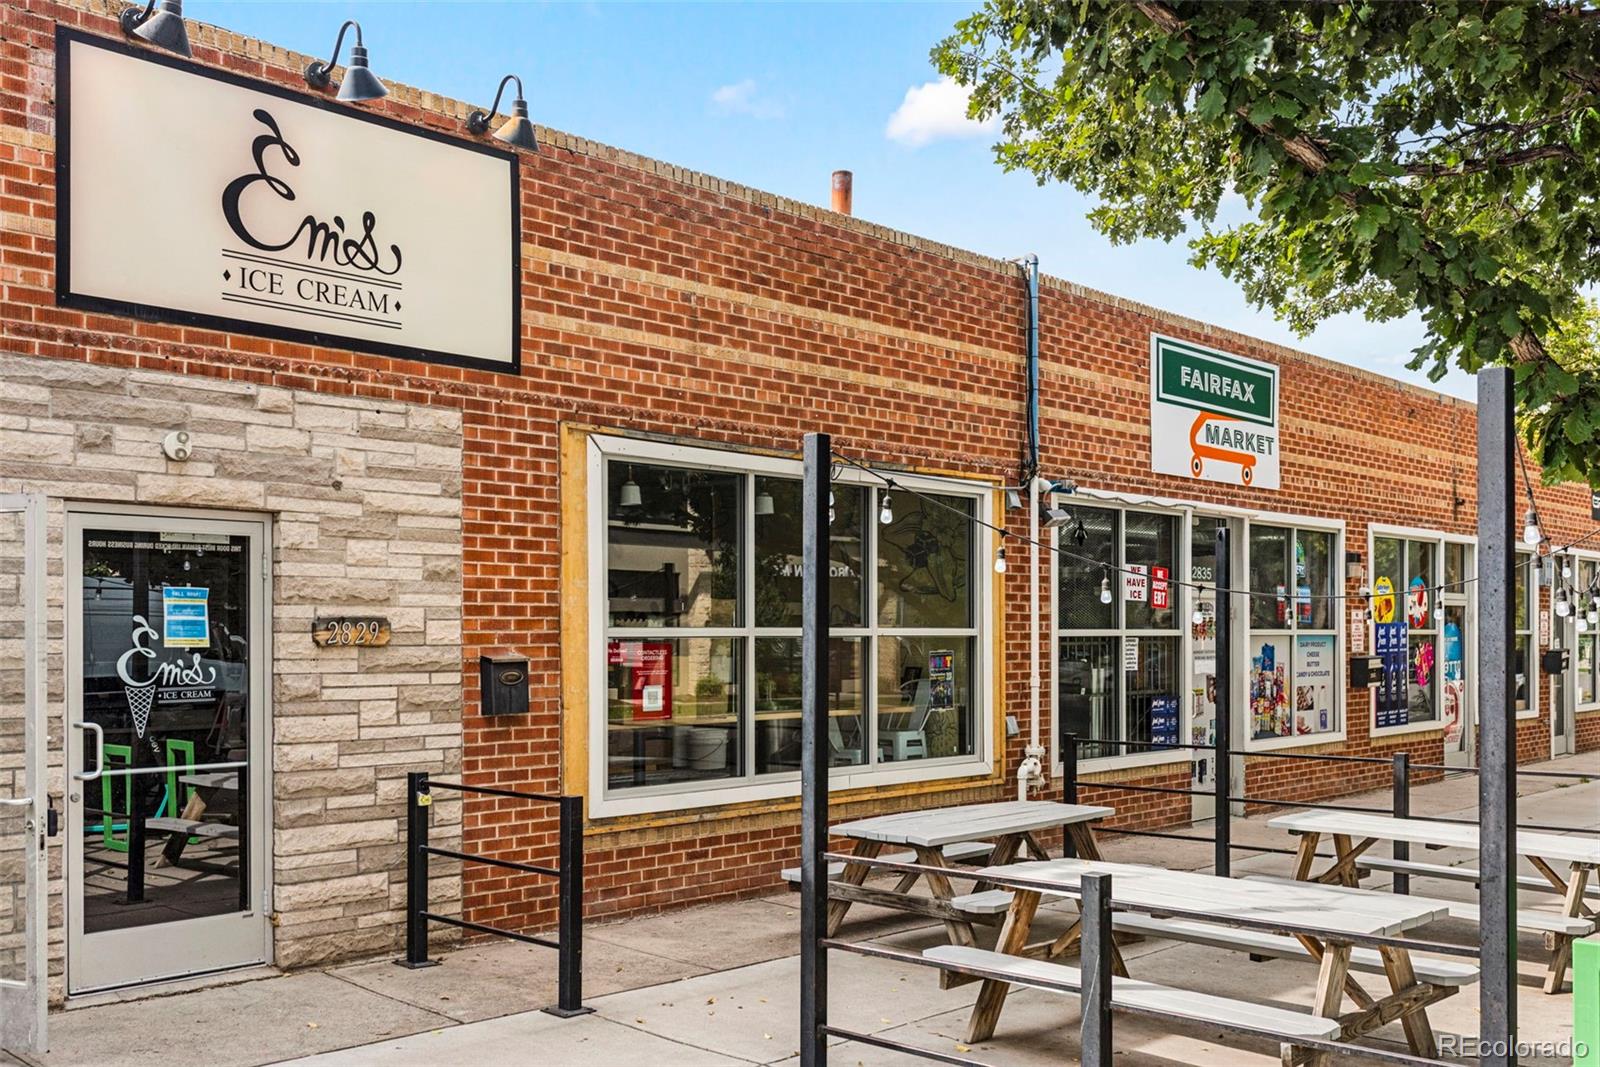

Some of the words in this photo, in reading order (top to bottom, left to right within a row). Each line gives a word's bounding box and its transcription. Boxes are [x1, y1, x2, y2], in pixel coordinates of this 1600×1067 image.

[222, 109, 402, 275] Em's
[239, 267, 285, 295] ICE
[296, 279, 389, 314] CREAM
[1180, 366, 1255, 404] FAIRFAX
[1205, 424, 1275, 455] MARKET
[1192, 566, 1212, 580] 2835
[1126, 578, 1146, 587] HAVE
[1130, 591, 1142, 599] ICE
[1153, 591, 1166, 605] EBT
[327, 621, 379, 644] 2829
[163, 691, 178, 699] ICE
[180, 690, 212, 699] CREAM
